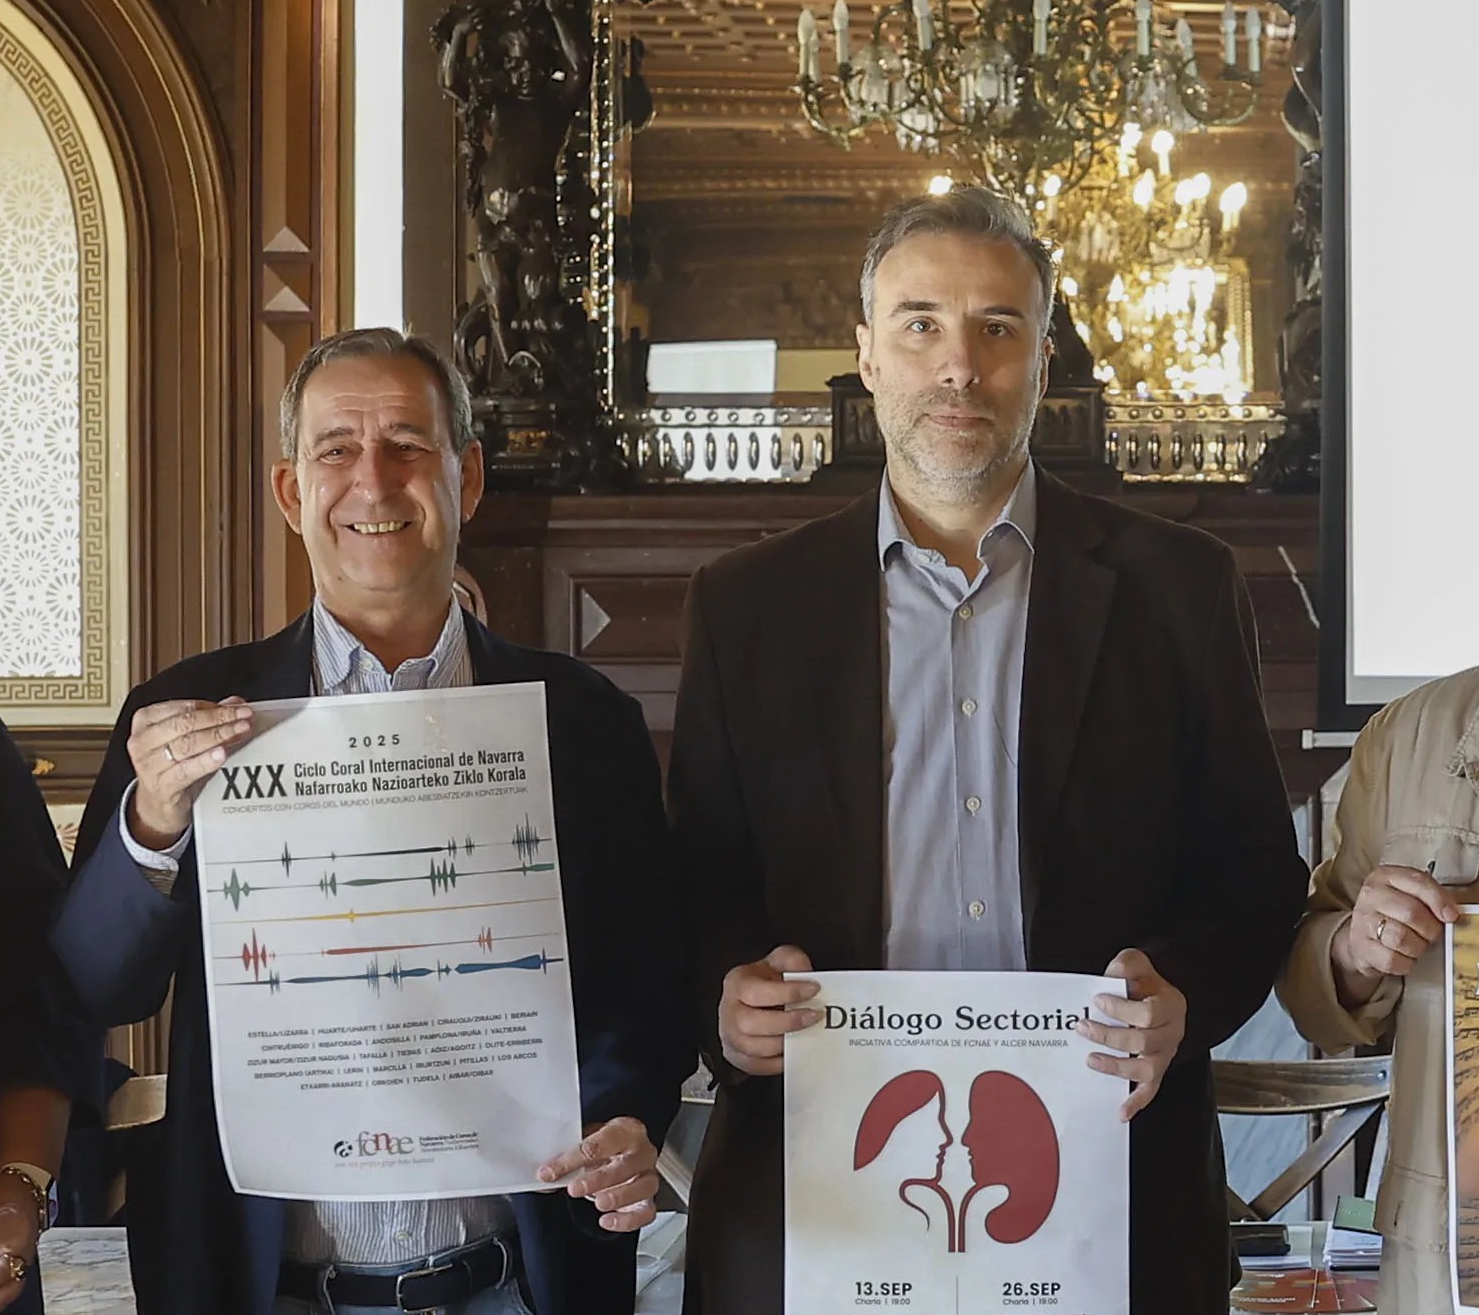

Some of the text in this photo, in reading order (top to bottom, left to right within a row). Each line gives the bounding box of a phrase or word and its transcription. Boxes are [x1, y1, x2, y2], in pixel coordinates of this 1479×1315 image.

[349, 734, 400, 748] 2025
[294, 750, 524, 778] Ciclo Coral Internacional de Navarra
[221, 764, 288, 801] XXX
[296, 766, 526, 796] Nafarroako Nazioarteko Ziklo Korala
[825, 1006, 942, 1035] Diálogo
[849, 1039, 892, 1047] INICIATIVA
[894, 1039, 949, 1047] COMPARTIDA
[951, 1039, 963, 1047] DE
[856, 1282, 912, 1296] 13.SEP
[1003, 1282, 1061, 1296] 26.SEP
